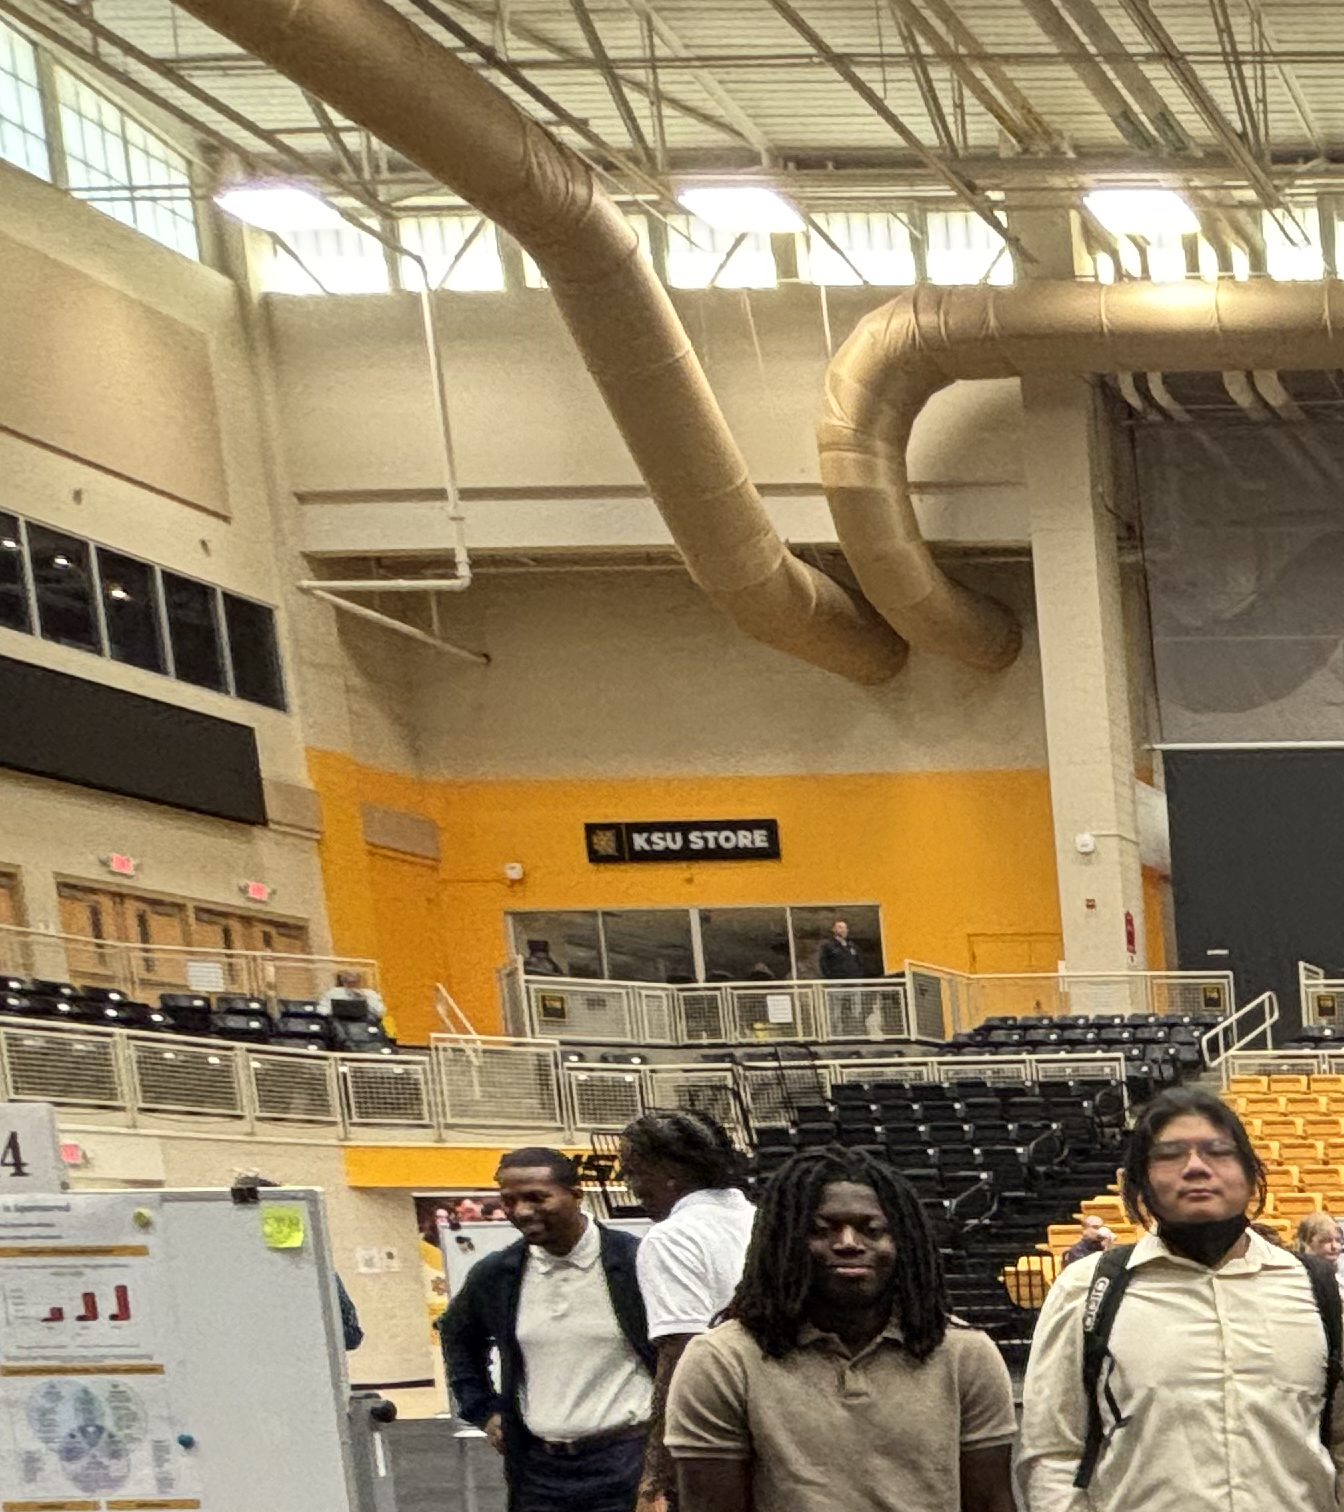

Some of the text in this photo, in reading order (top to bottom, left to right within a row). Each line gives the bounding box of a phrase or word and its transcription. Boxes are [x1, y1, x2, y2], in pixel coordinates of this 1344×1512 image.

[631, 829, 770, 851] KSU STORE
[0, 1130, 32, 1177] 4
